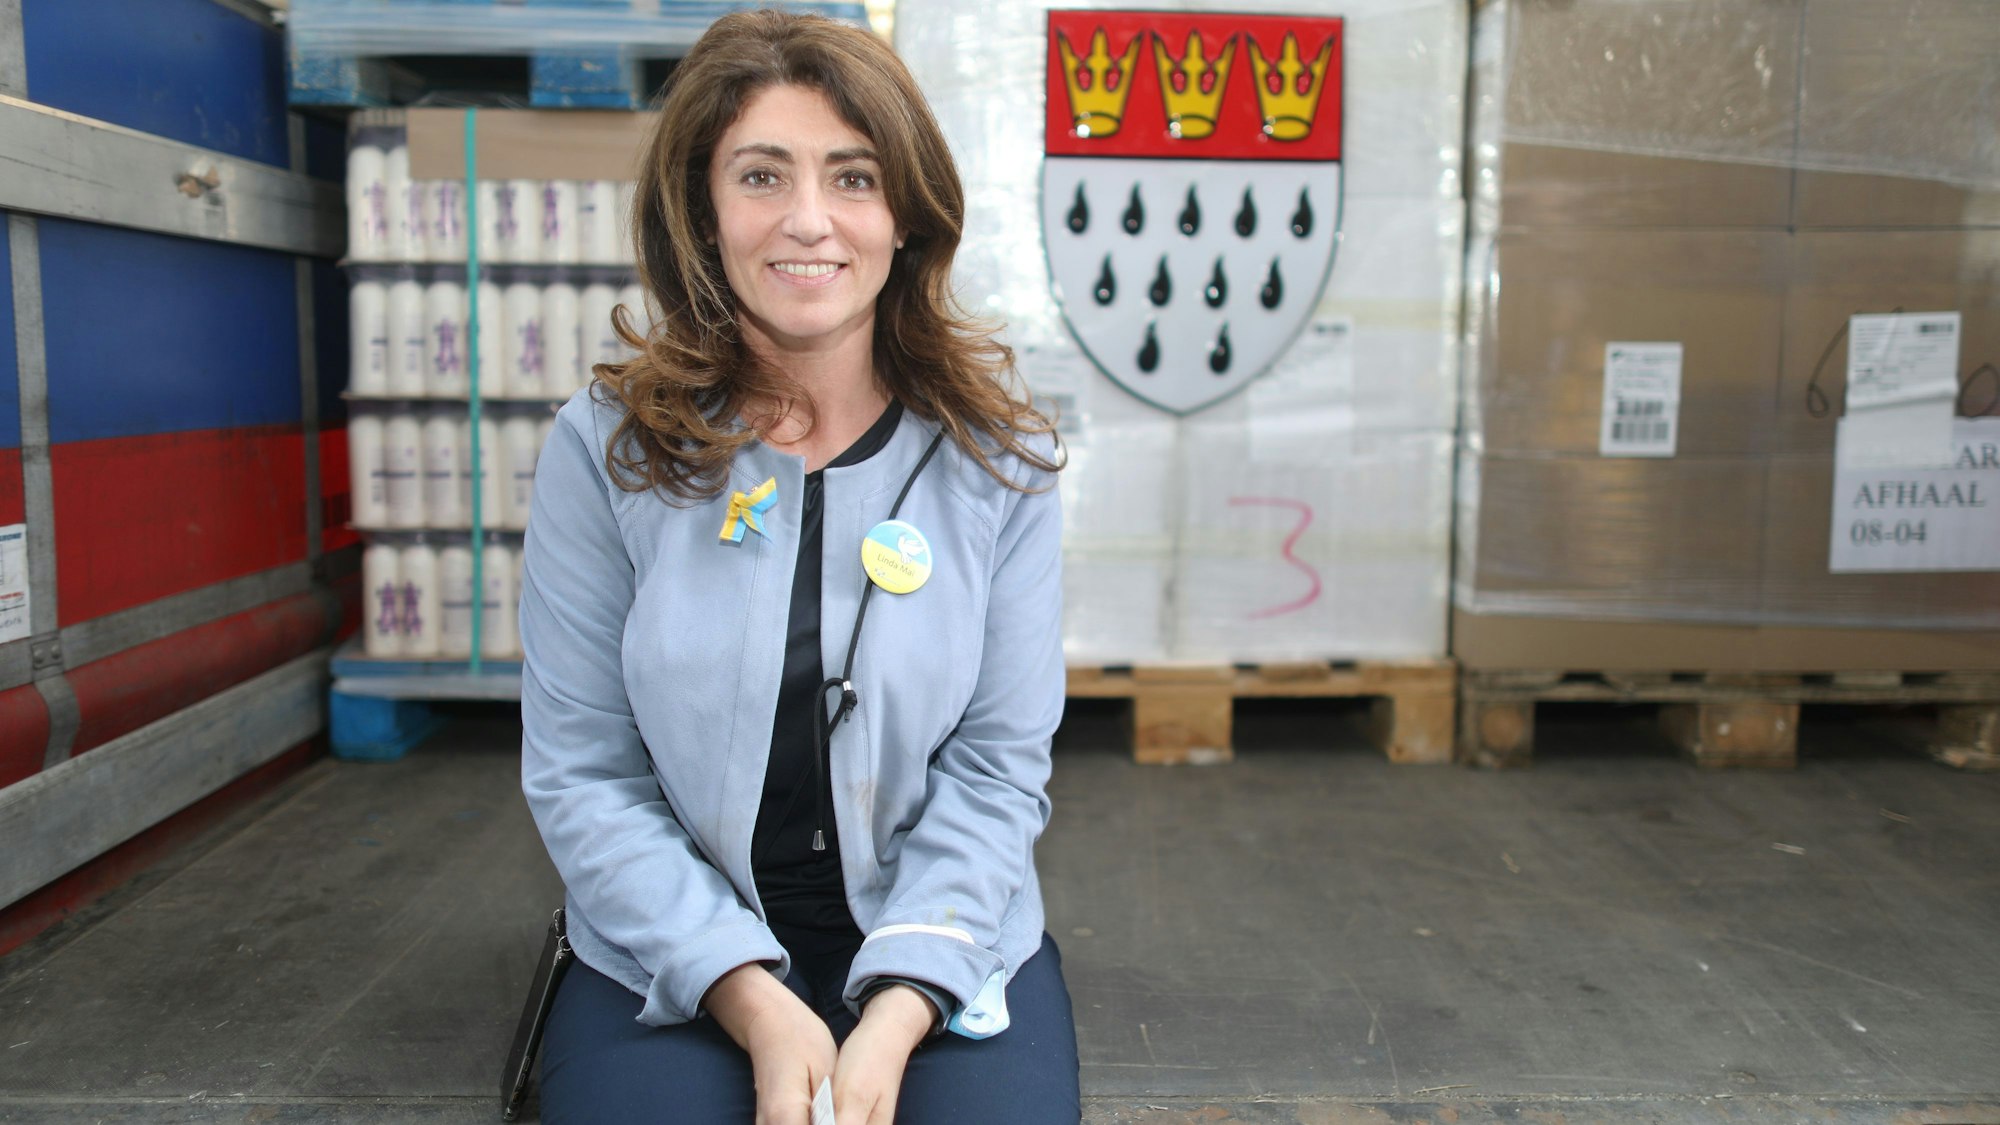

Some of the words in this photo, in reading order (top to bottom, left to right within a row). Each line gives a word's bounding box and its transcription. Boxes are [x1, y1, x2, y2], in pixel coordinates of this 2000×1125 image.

[1953, 443, 2000, 470] AR
[1853, 481, 1986, 508] AFHAAL
[1851, 519, 1927, 546] 08-04
[877, 553, 898, 570] Linda
[1227, 497, 1322, 620] 3
